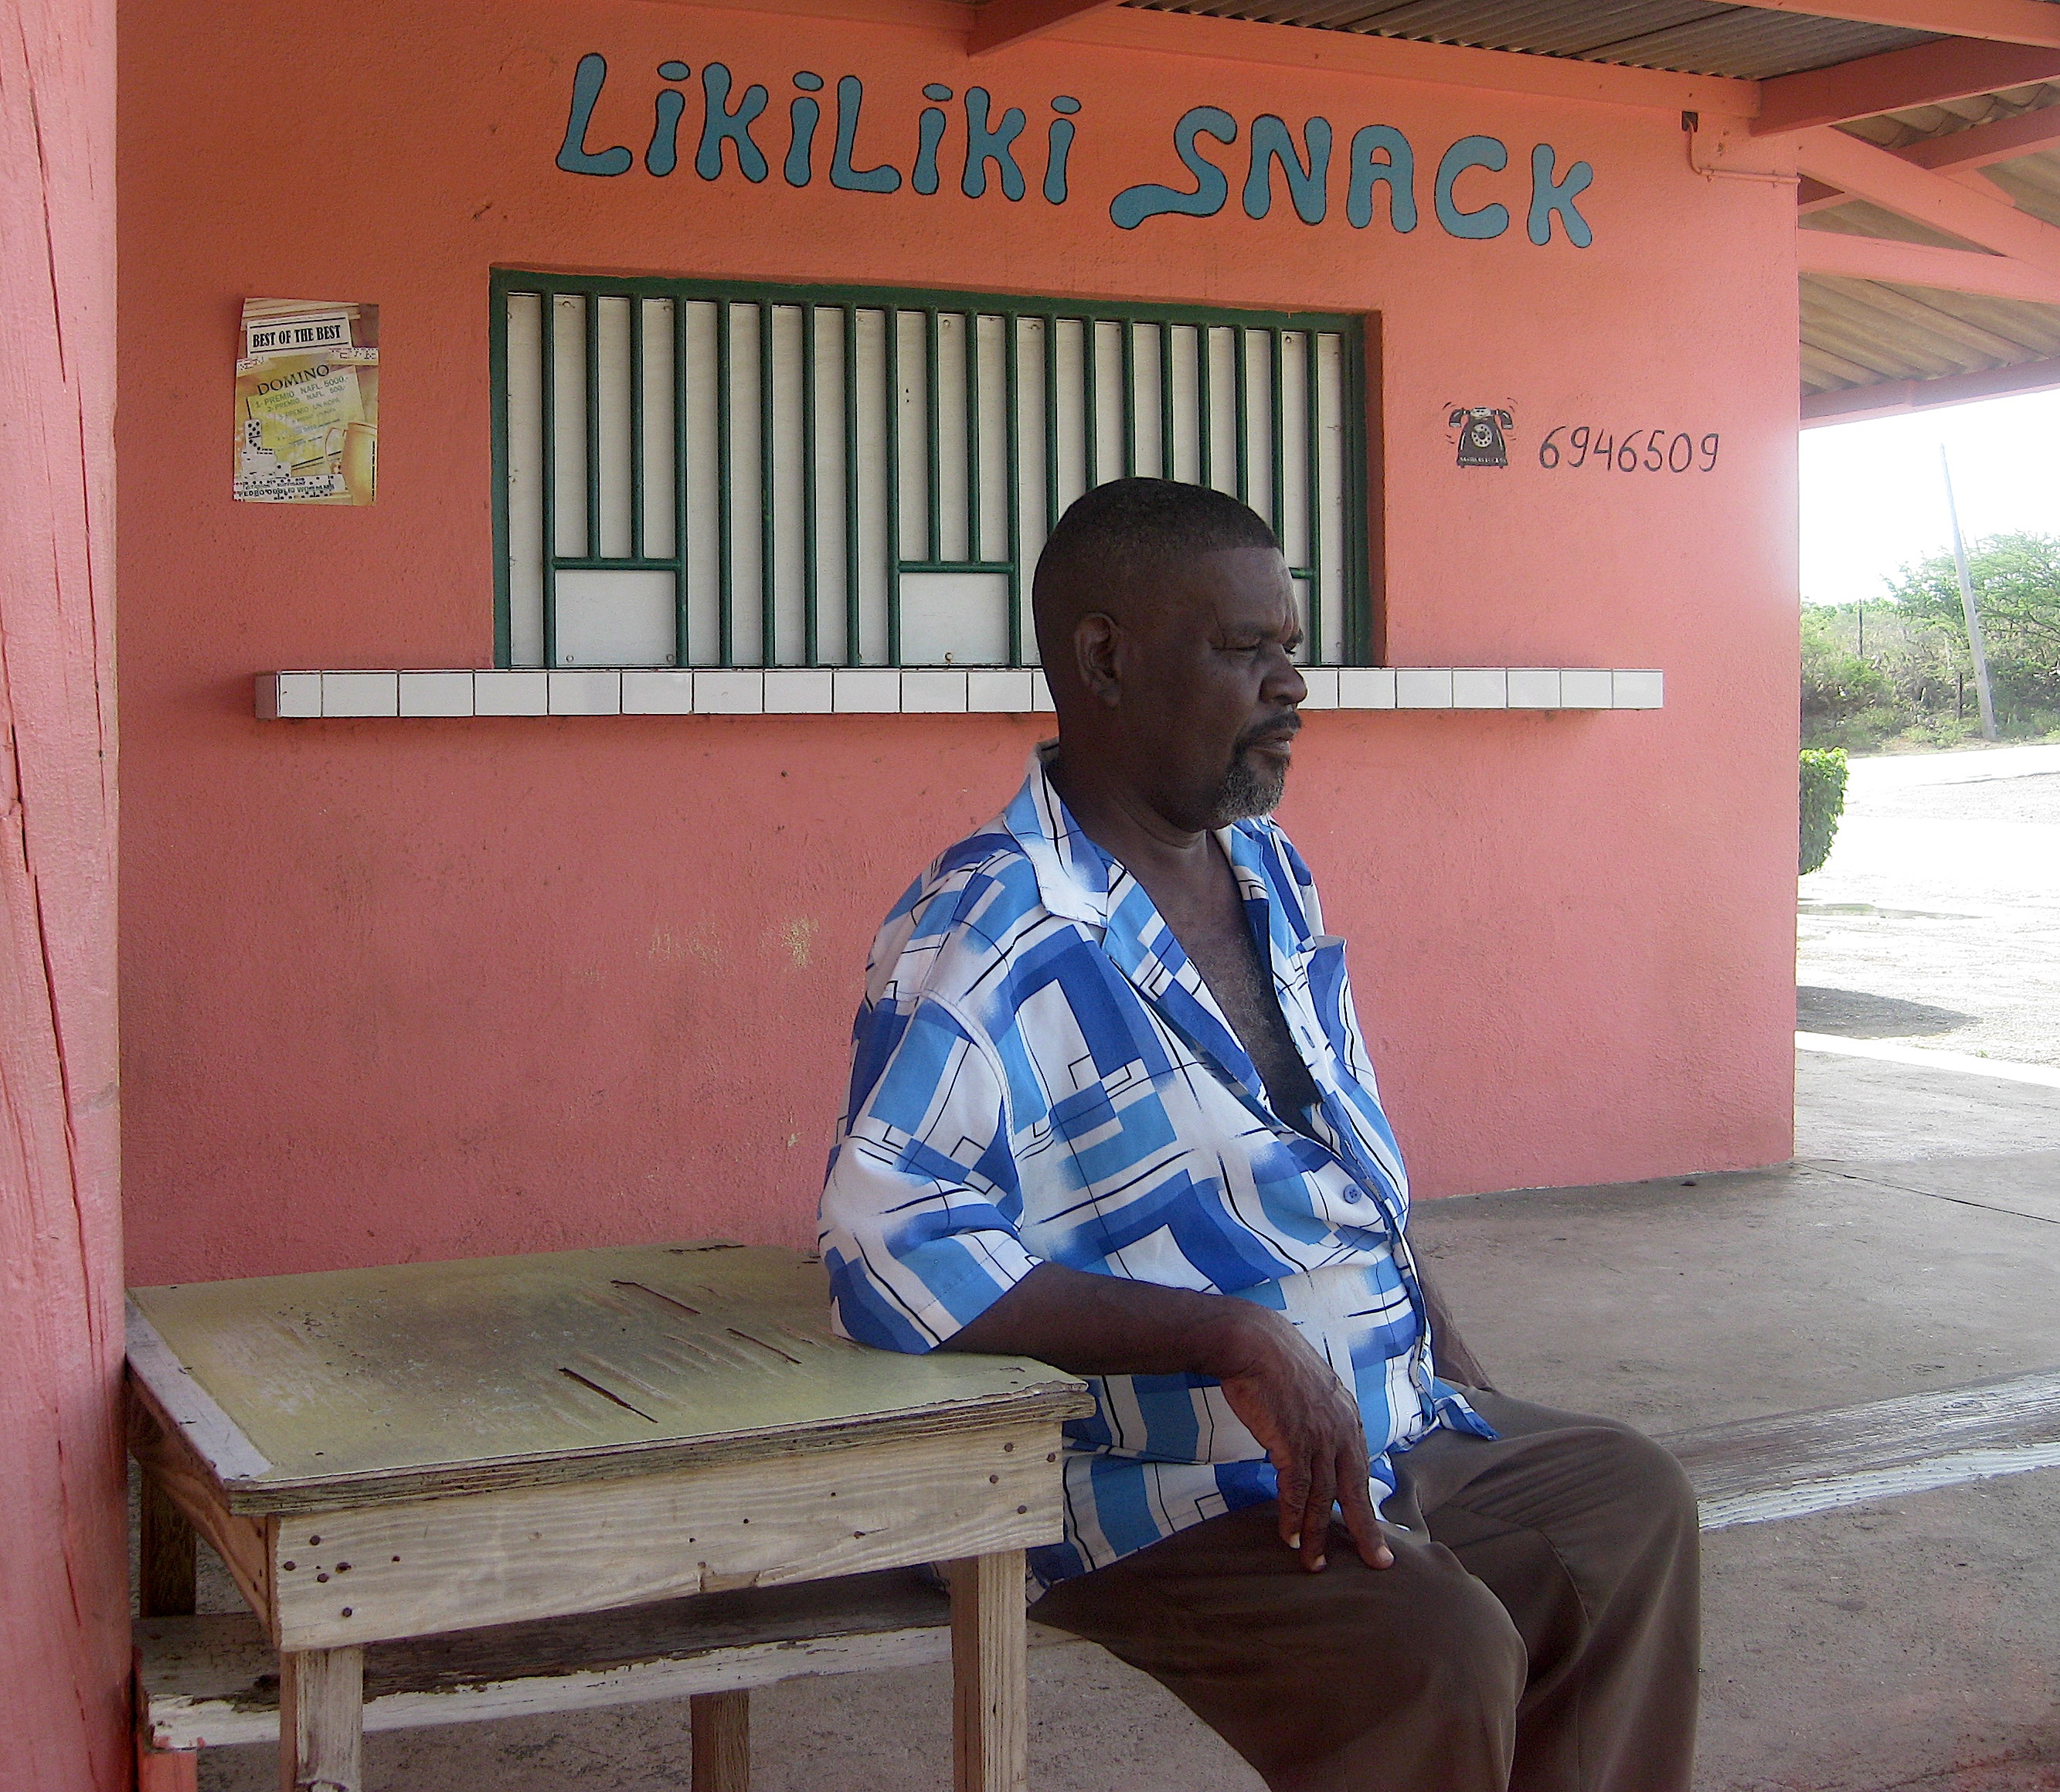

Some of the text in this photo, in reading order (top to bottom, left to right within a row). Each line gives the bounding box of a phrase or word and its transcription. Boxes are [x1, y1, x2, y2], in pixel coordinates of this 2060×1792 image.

[1110, 105, 1593, 248] SNACK
[253, 325, 341, 347] BEST OF THE BEST
[257, 364, 330, 395] DOMINO
[1538, 426, 1719, 473] 6946509
